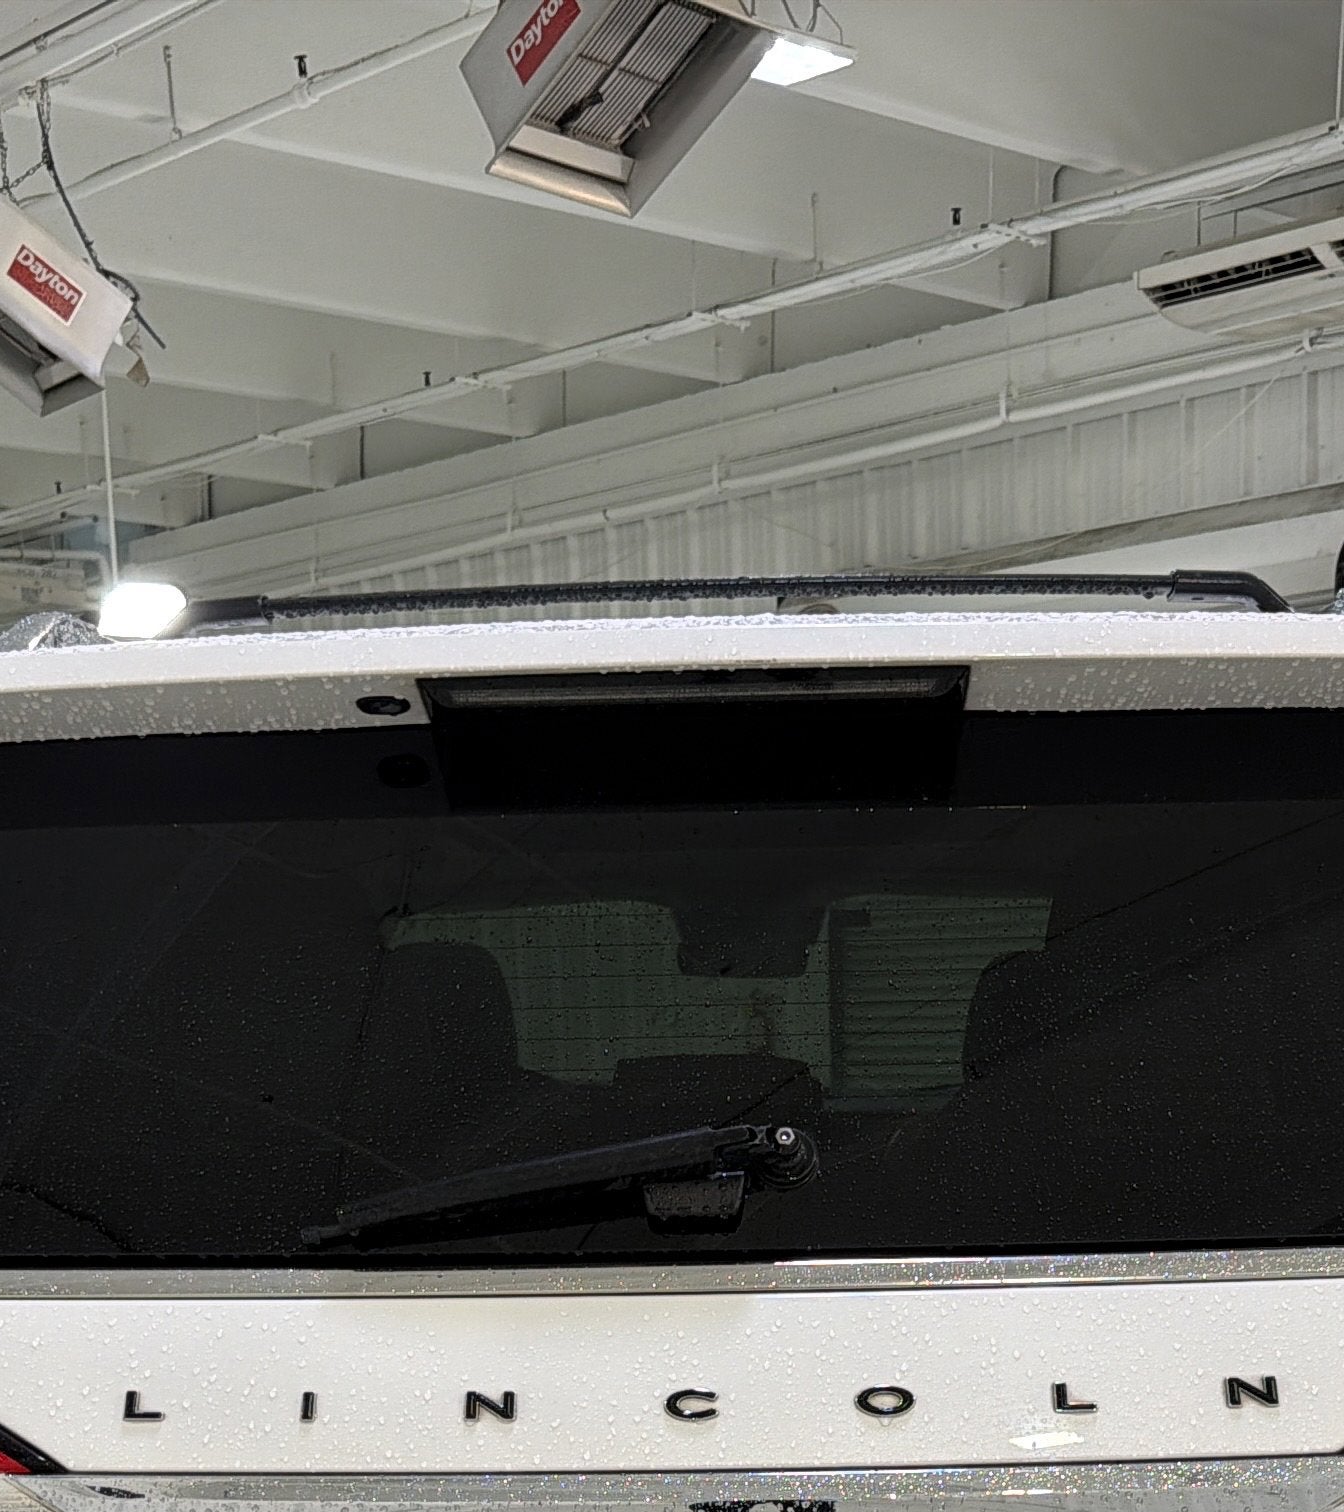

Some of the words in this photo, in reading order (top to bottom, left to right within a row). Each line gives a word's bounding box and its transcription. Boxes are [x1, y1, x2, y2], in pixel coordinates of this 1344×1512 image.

[511, 0, 563, 65] Dayto
[17, 249, 79, 305] Dayton
[123, 1374, 1280, 1422] LINCOLN
